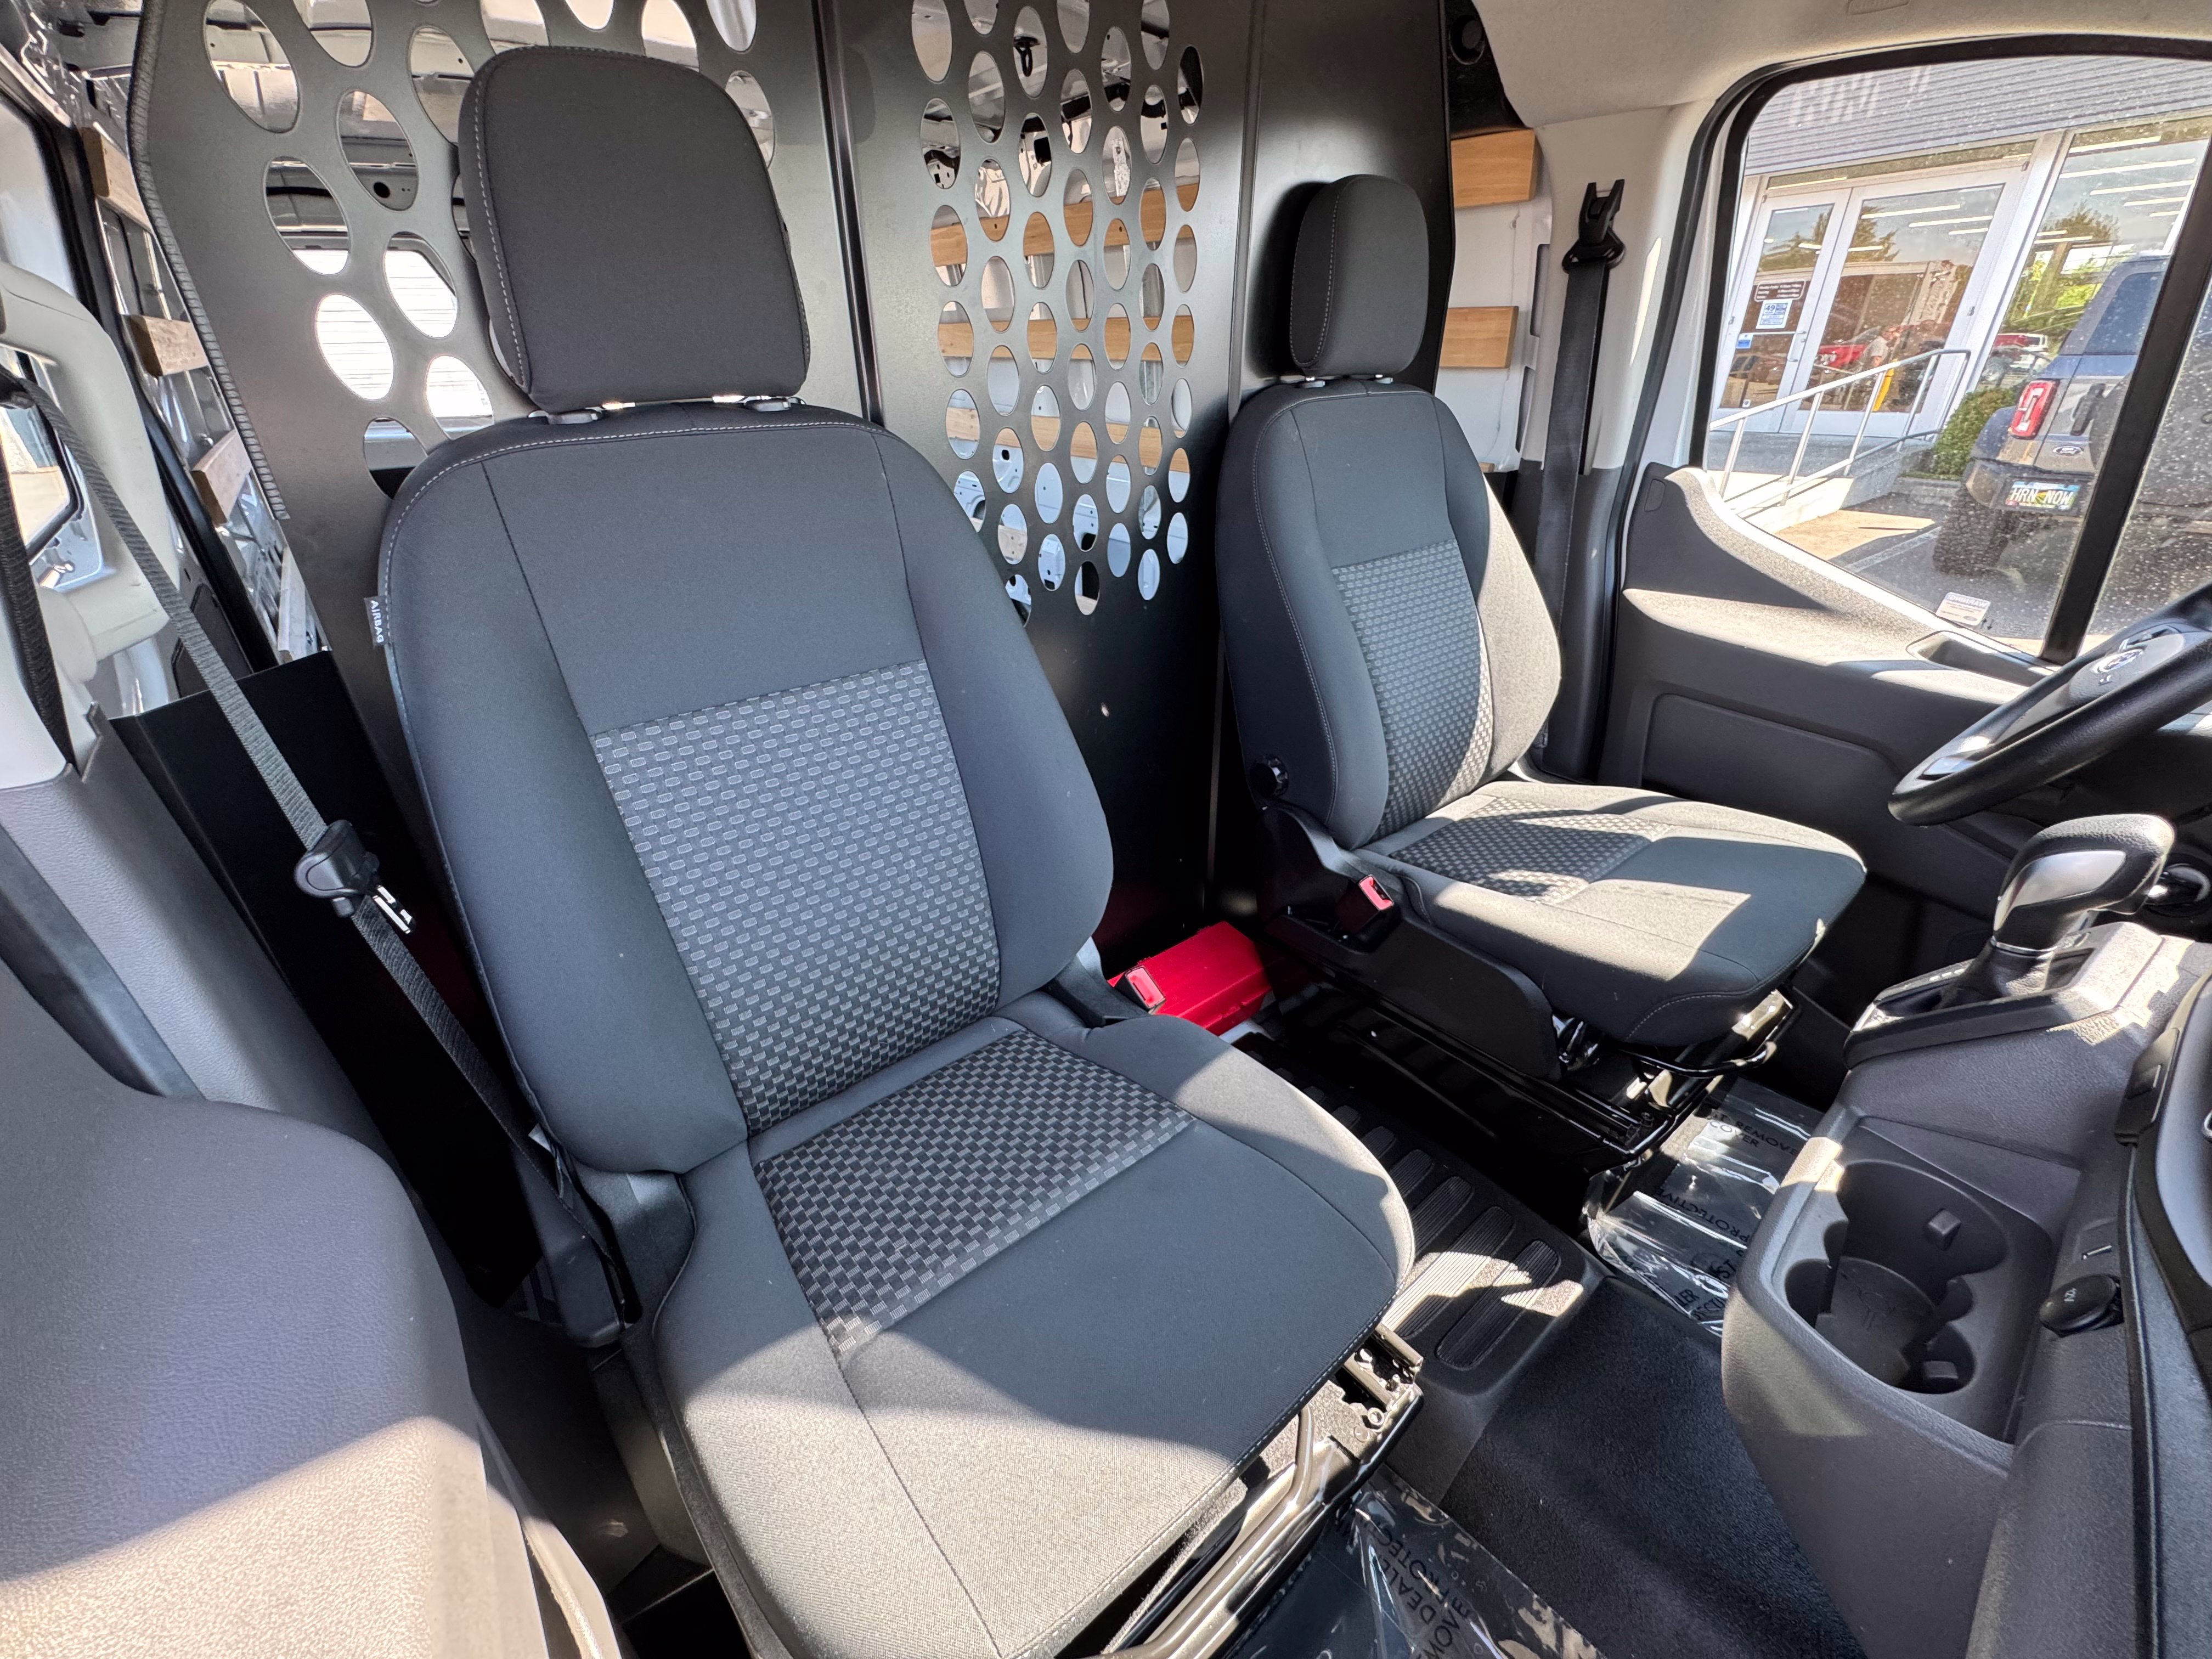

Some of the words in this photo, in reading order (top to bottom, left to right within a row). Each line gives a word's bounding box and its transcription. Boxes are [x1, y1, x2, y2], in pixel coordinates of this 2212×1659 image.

[2010, 488, 2039, 503] HRN
[2044, 490, 2074, 505] NOW
[371, 600, 384, 643] AIRBAG
[1709, 1121, 1759, 1148] COVER
[1655, 1188, 1750, 1243] PROTECTIVE
